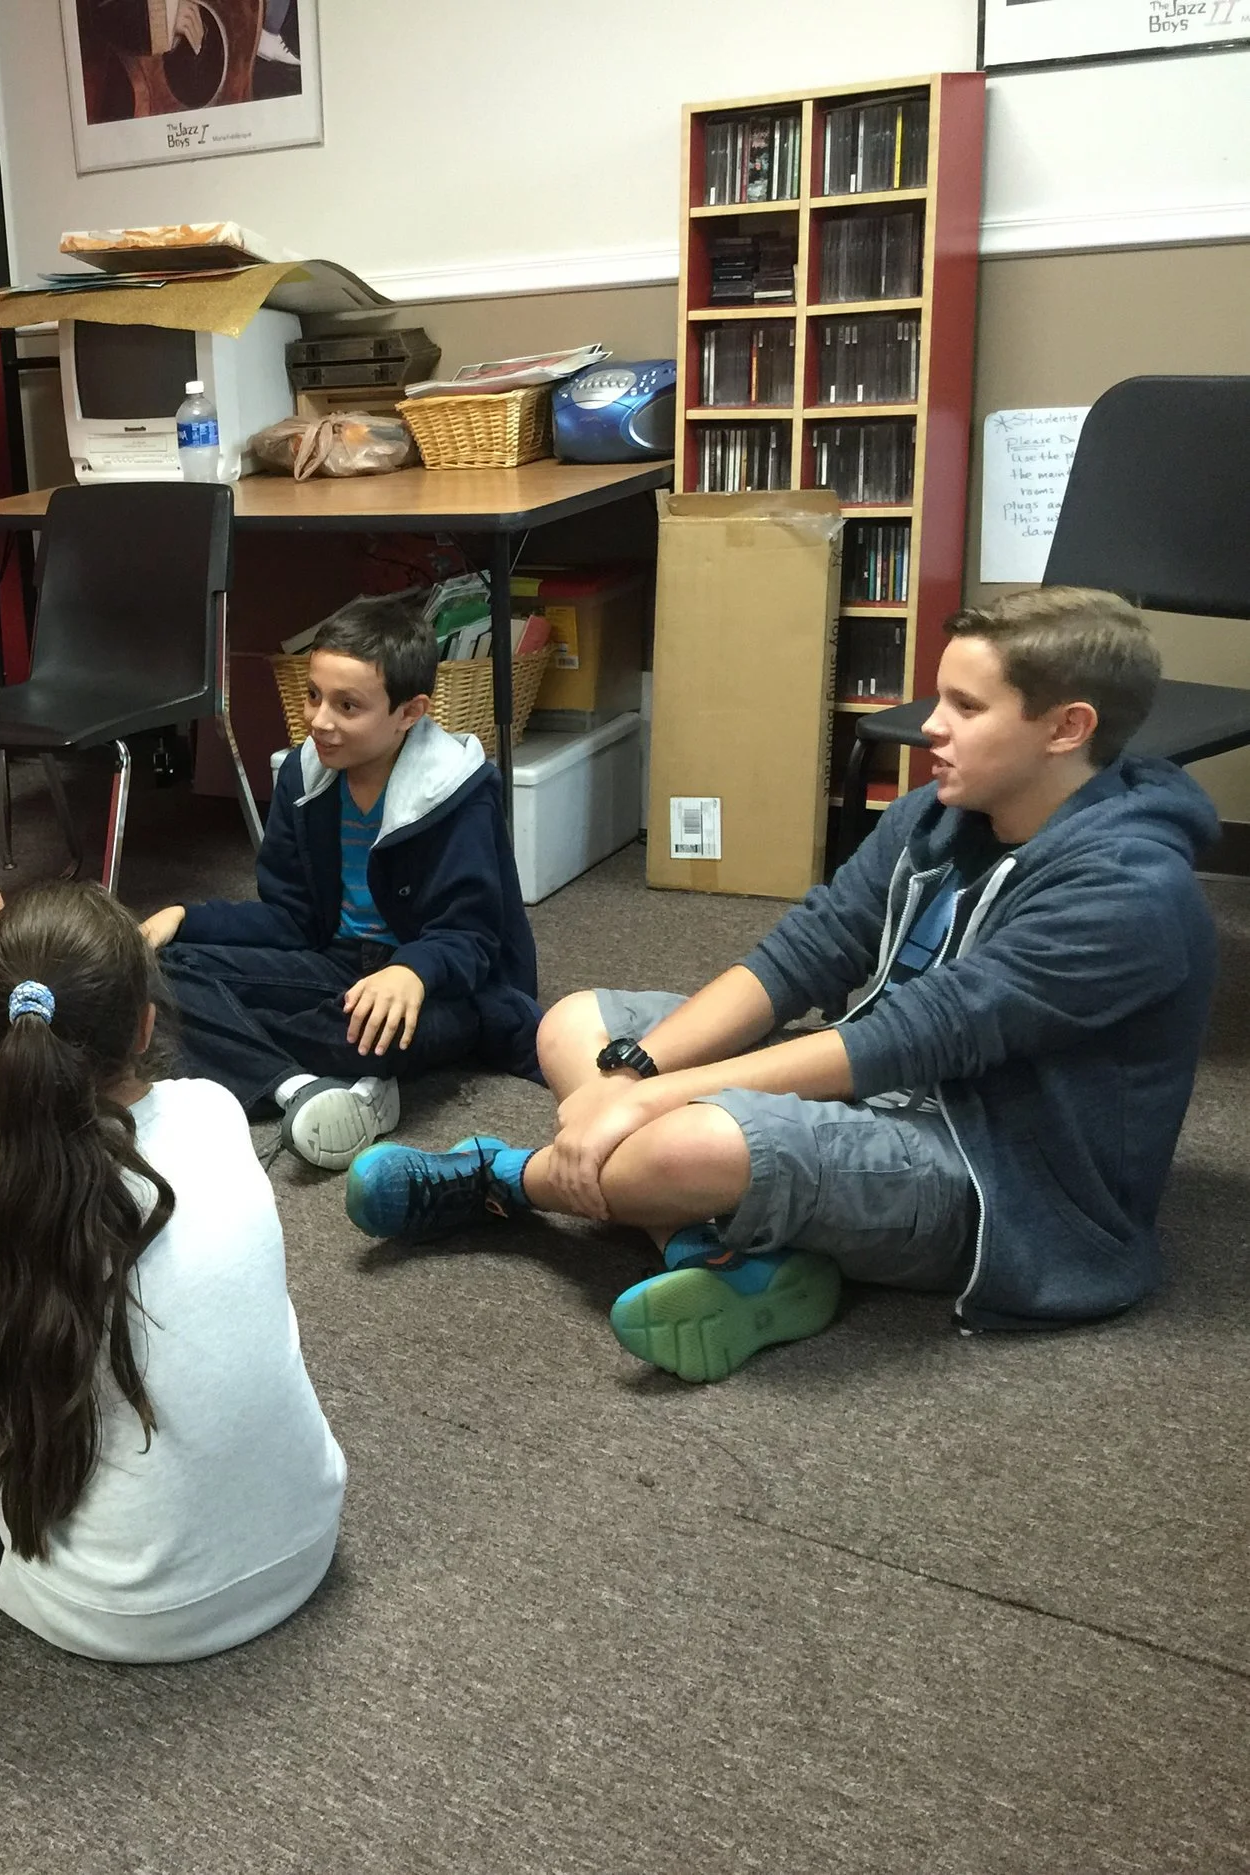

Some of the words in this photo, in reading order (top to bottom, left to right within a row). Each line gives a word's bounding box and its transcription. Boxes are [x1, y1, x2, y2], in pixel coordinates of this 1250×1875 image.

[1165, 0, 1206, 18] Jazz
[1203, 0, 1238, 26] II
[1149, 15, 1189, 33] Boys
[175, 122, 199, 137] Jazz
[167, 134, 190, 148] Boys
[1012, 412, 1078, 427] Students
[1040, 451, 1060, 462] the
[1010, 468, 1033, 480] the
[1002, 501, 1039, 521] plugs
[1011, 513, 1040, 526] this
[1021, 525, 1054, 538] dam
